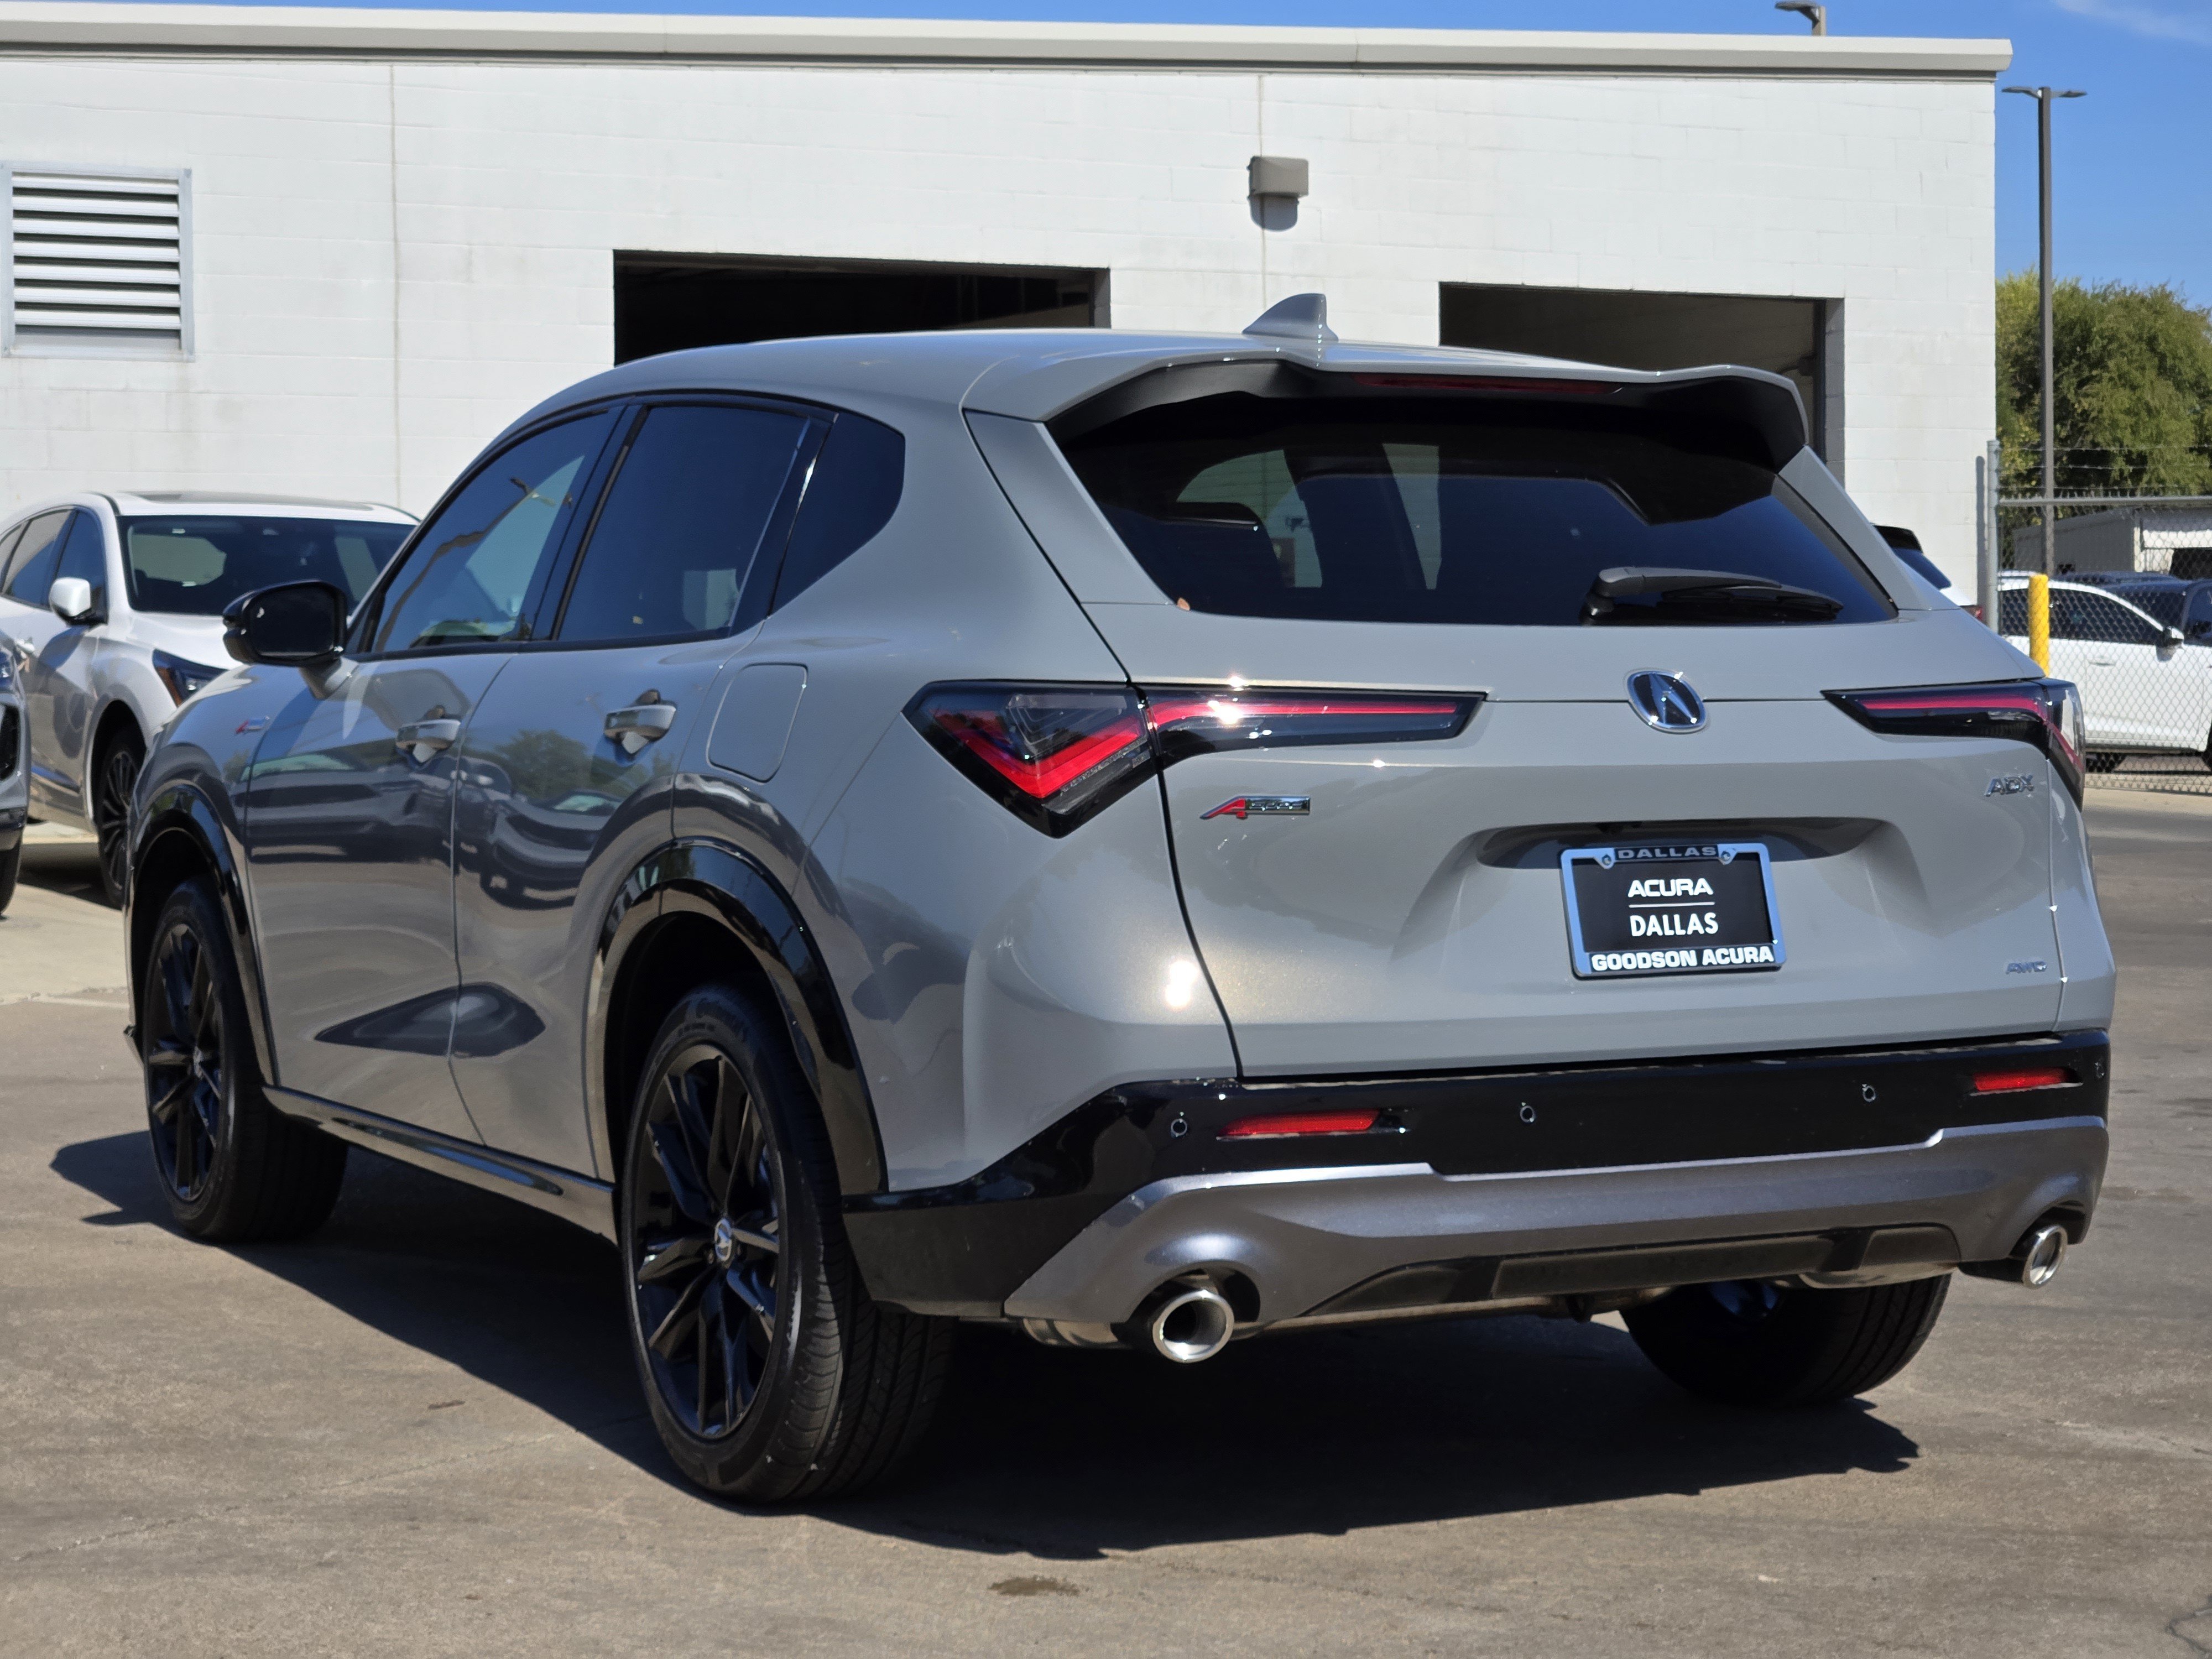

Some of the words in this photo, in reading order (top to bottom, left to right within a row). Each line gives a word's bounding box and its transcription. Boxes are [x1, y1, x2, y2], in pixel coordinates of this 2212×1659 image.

[1618, 847, 1716, 858] DALLAS
[1628, 878, 1713, 897] ACURA
[1630, 912, 1718, 936] DALLAS
[1592, 951, 1698, 971] GOODSON
[1702, 946, 1774, 965] ACURA
